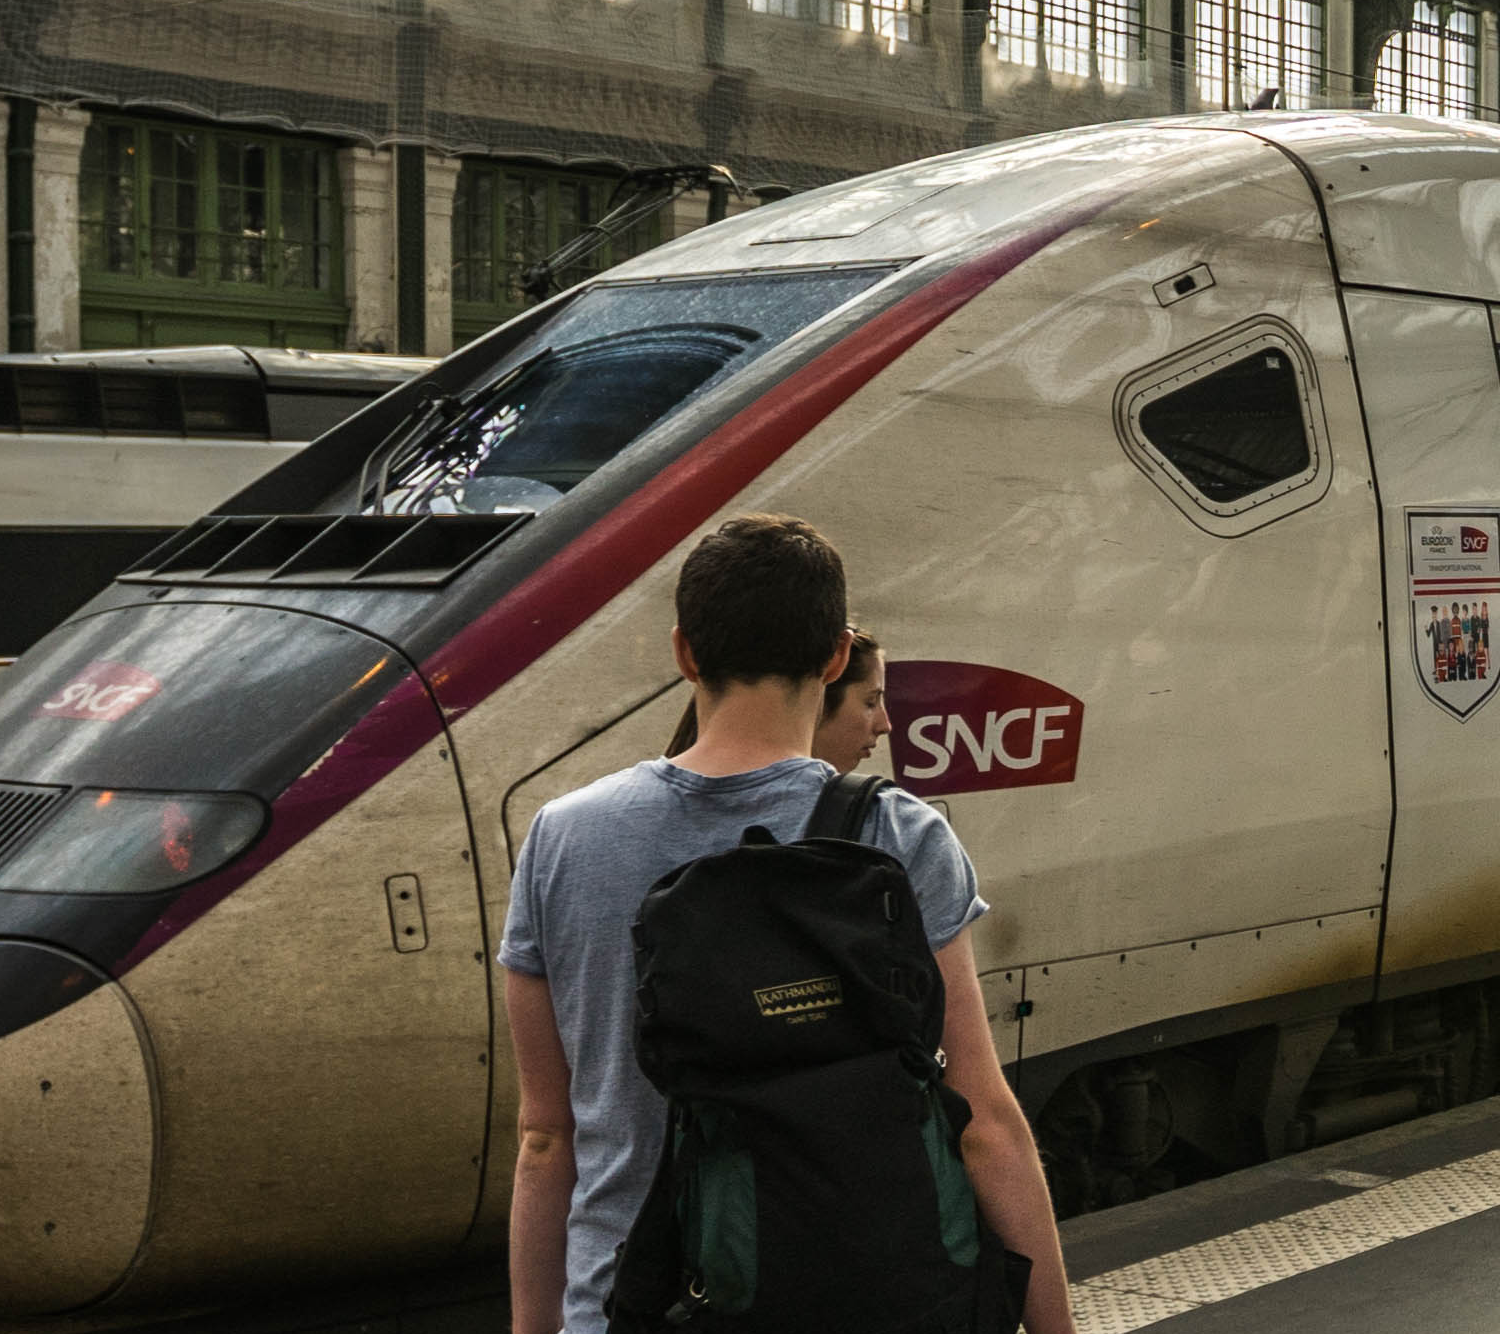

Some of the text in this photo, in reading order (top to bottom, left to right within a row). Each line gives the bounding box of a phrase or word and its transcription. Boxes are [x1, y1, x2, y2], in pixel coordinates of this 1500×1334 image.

[1463, 537, 1487, 550] SNCF
[42, 682, 152, 712] SNCF
[903, 705, 1071, 779] SNCF
